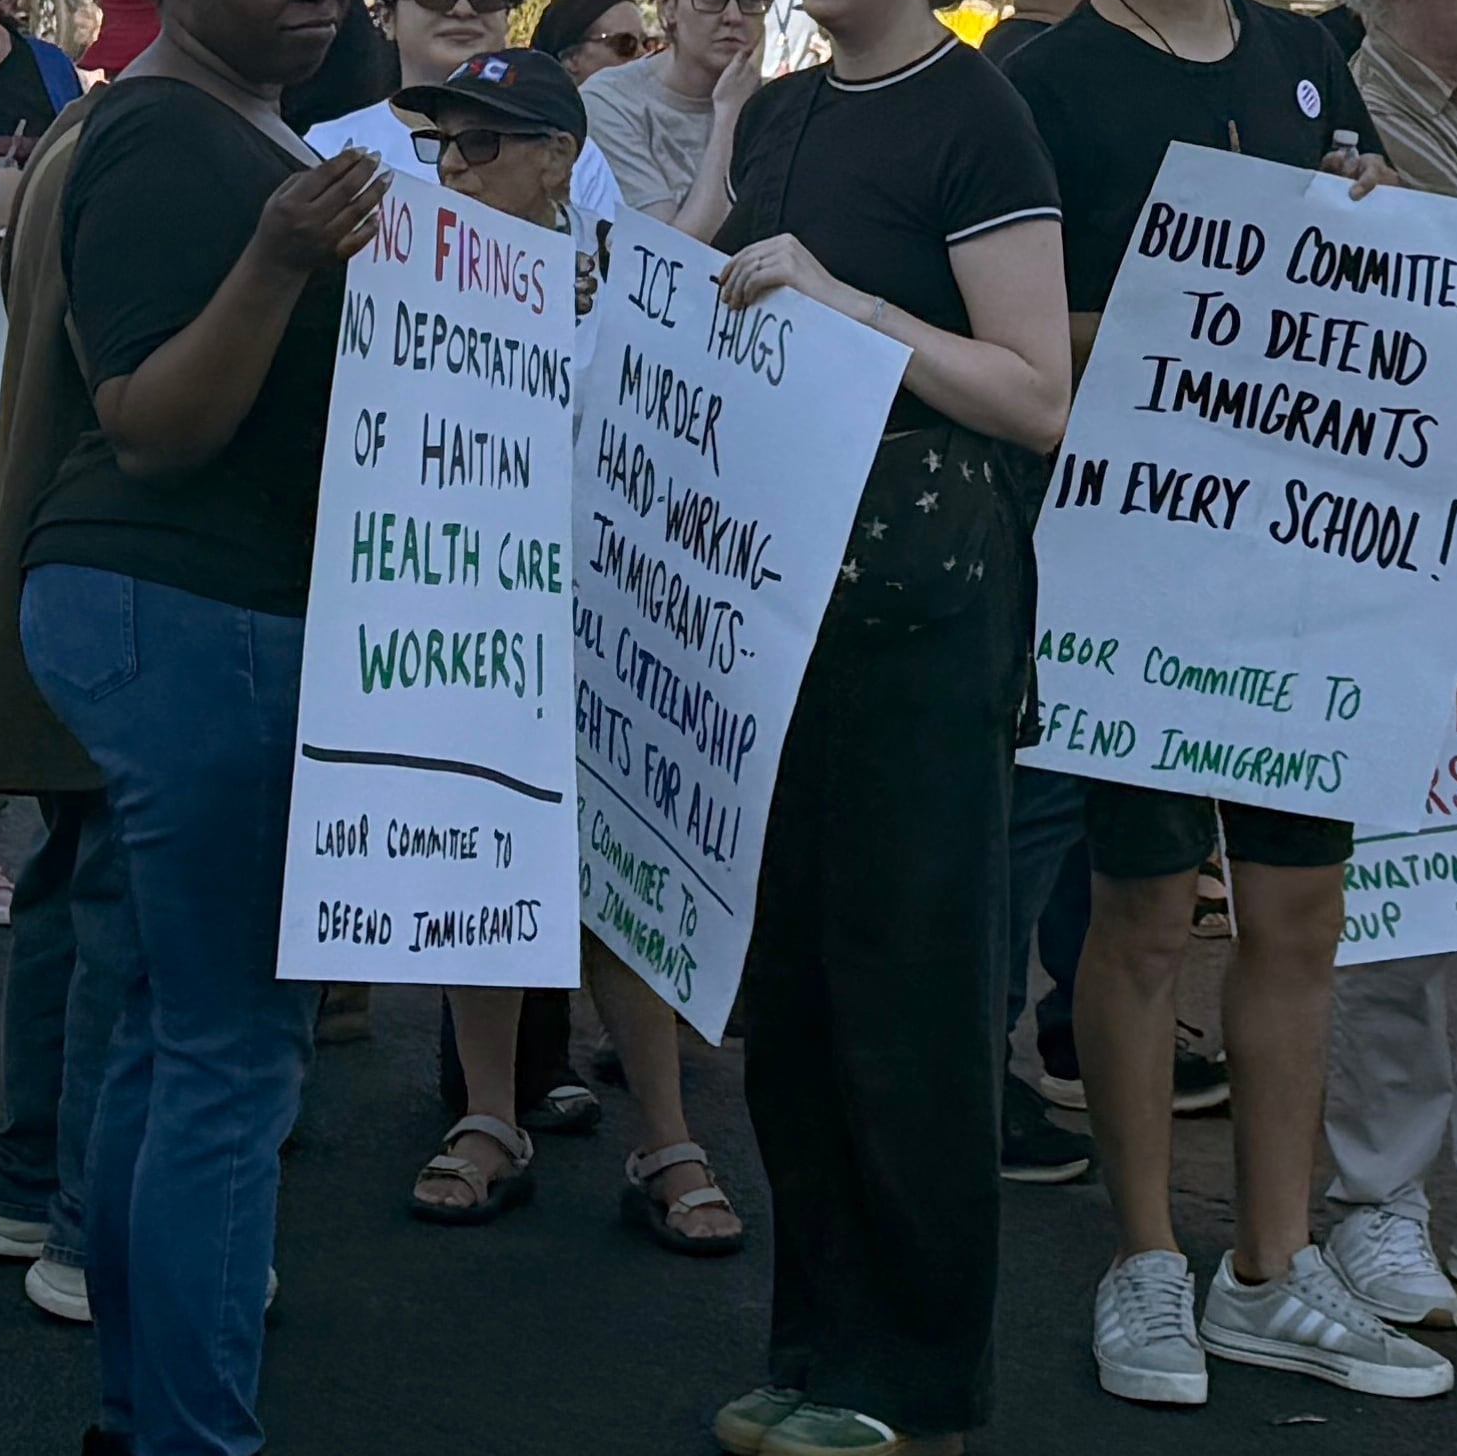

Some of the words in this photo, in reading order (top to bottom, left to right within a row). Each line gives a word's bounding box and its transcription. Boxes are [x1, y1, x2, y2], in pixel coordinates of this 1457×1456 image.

[375, 199, 412, 265] NO
[434, 207, 546, 316] FIRINGS
[1138, 201, 1266, 277] BUILD
[343, 289, 375, 360] NO
[393, 309, 572, 411] DEPORTATIONS
[627, 244, 684, 331] ICE
[708, 273, 794, 387] THUGS
[1183, 290, 1241, 347] TO
[1263, 307, 1428, 387] DEFEND
[354, 408, 386, 469] OF
[420, 412, 531, 491] HAITIAN
[618, 344, 722, 476] MURDER
[1134, 354, 1439, 470] IMMIGRANTS
[1054, 452, 1108, 510] IN
[1119, 460, 1251, 531] EVERY
[351, 510, 480, 589] HEALTH
[497, 537, 564, 595] CARE
[358, 624, 546, 720] WORKERS!
[573, 594, 605, 659] ULL
[616, 626, 757, 785] CITIZENSHIP
[1035, 627, 1120, 677] ABOR
[1142, 645, 1300, 716] COMMITTEE
[1324, 675, 1362, 722] TO
[575, 679, 633, 776] GHTS
[644, 742, 682, 831] FOR
[686, 781, 742, 873] ALL!
[1037, 698, 1137, 759] FEND
[1149, 726, 1351, 795] IMMIGRANTS
[315, 813, 369, 860] LABOR
[386, 818, 479, 862] COMMITTEE
[493, 829, 513, 869] TO
[591, 809, 671, 914] COMMITTEE
[678, 882, 698, 938] TO
[318, 901, 393, 946] DEFEND
[408, 899, 540, 954] IMMIGRANTS
[596, 881, 698, 1004] IMMIGRANTS
[1340, 901, 1402, 943] OUP
